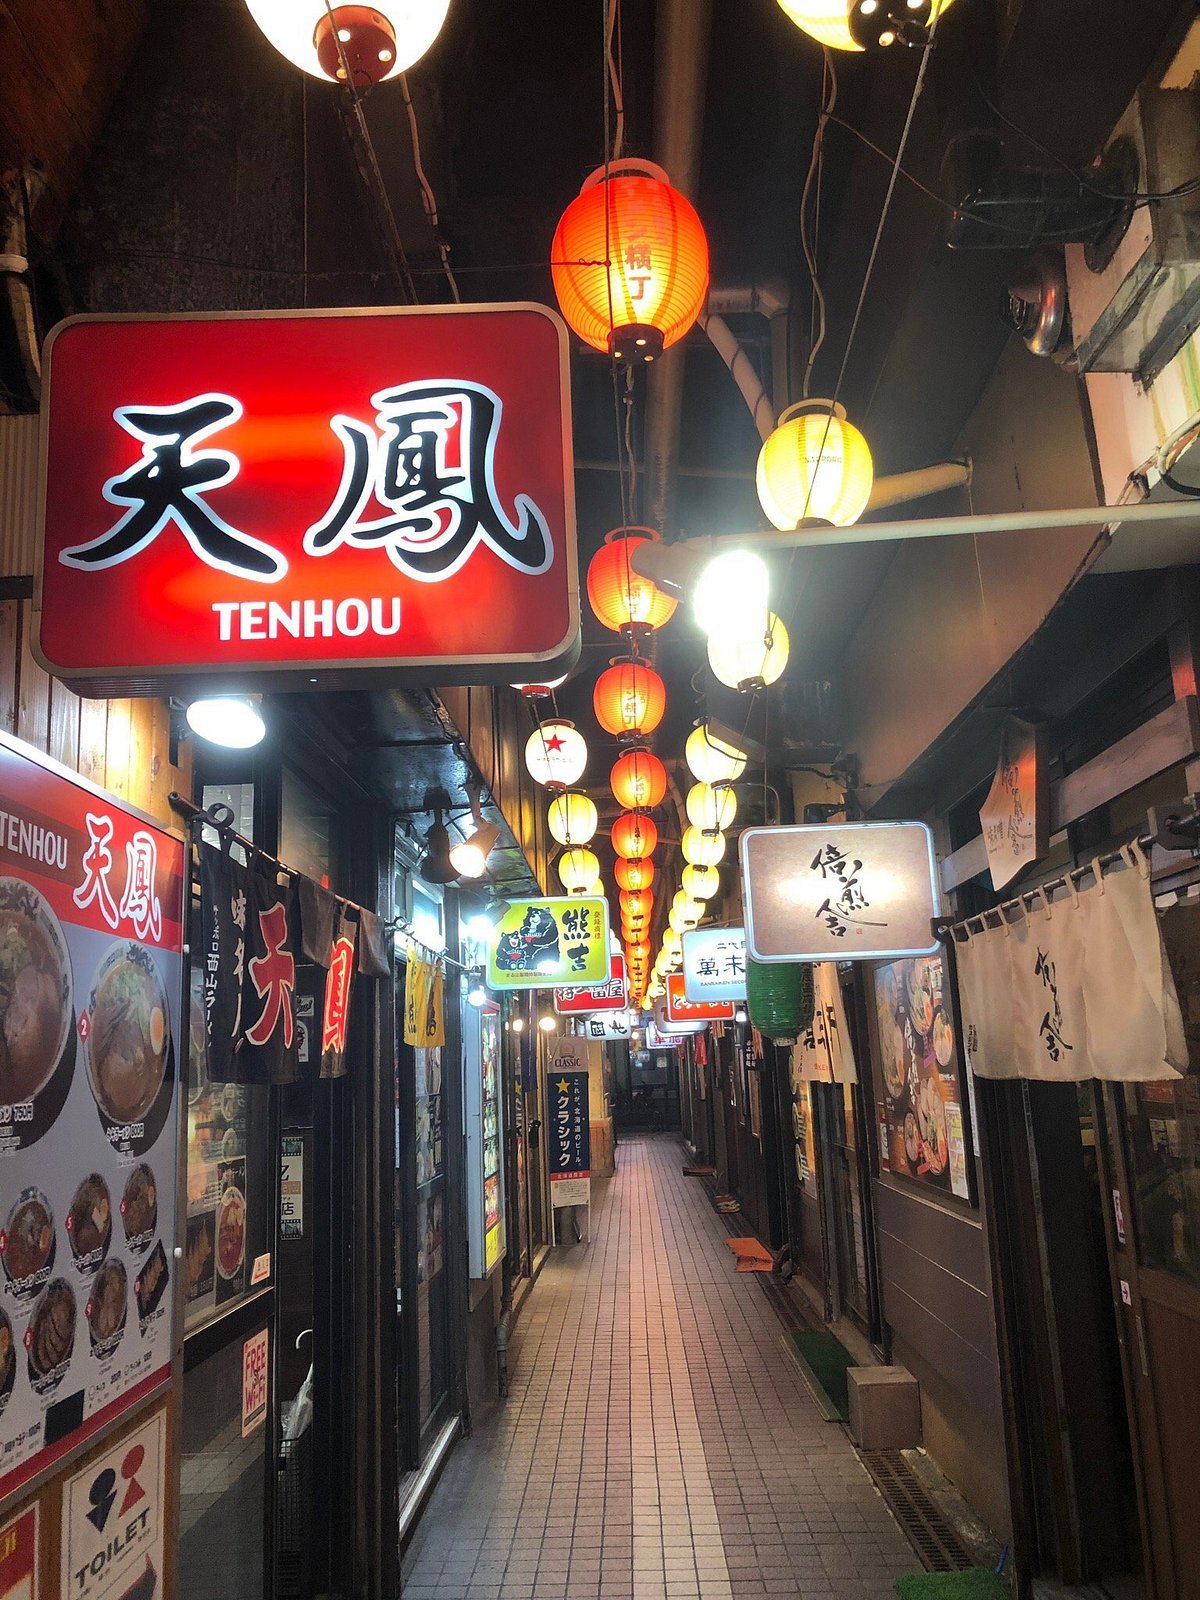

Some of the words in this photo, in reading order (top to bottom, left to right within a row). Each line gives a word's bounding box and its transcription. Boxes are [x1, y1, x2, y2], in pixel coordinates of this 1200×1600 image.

[58, 378, 554, 583] 天鳳
[212, 597, 401, 641] TENHOU
[0, 810, 68, 870] TENHOU
[73, 812, 162, 942] 天鳳
[561, 906, 591, 972] 熊吉
[81, 1018, 87, 1035] 2
[554, 1056, 581, 1068] CLASSIC
[557, 1095, 571, 1167] クラシック
[245, 1341, 266, 1374] FREE
[245, 1375, 266, 1416] Wi-Fi
[75, 1506, 150, 1589] TOILET
